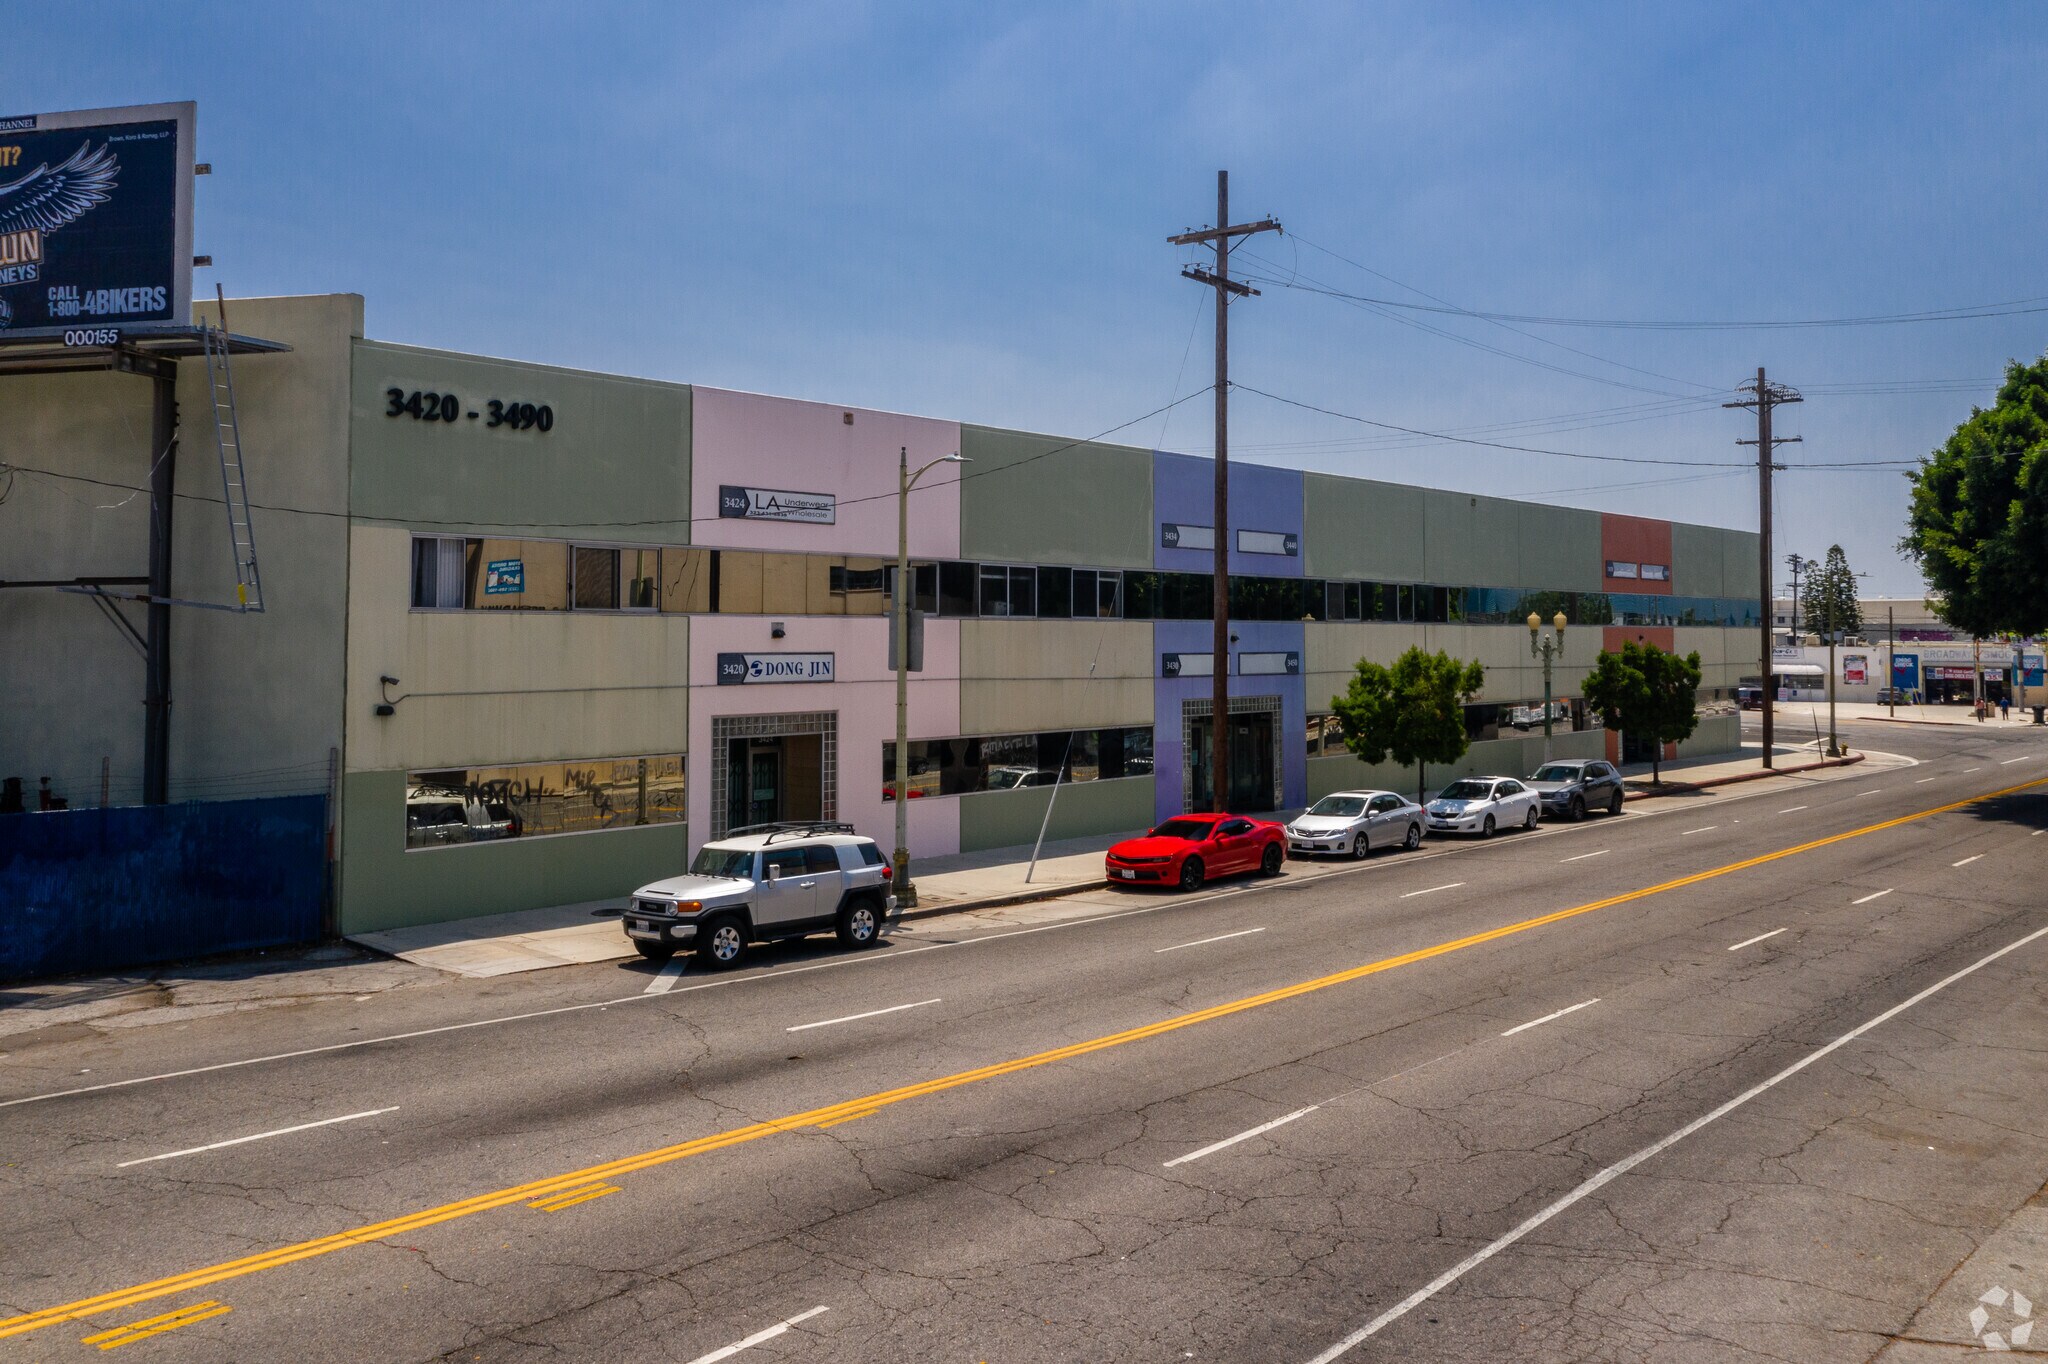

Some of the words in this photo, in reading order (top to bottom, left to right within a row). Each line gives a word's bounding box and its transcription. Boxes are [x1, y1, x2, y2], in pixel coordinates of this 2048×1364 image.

[48, 286, 80, 300] CALL
[65, 329, 119, 346] 000155
[386, 387, 460, 423] 3420
[486, 399, 554, 432] 3490
[724, 497, 746, 509] 3424
[755, 493, 780, 511] LA
[784, 498, 829, 508] Underwear
[787, 509, 828, 519] Wholesale
[1983, 649, 2012, 659] SMOG
[723, 664, 744, 675] 3420
[765, 662, 804, 676] DONG
[808, 662, 831, 677] JIN
